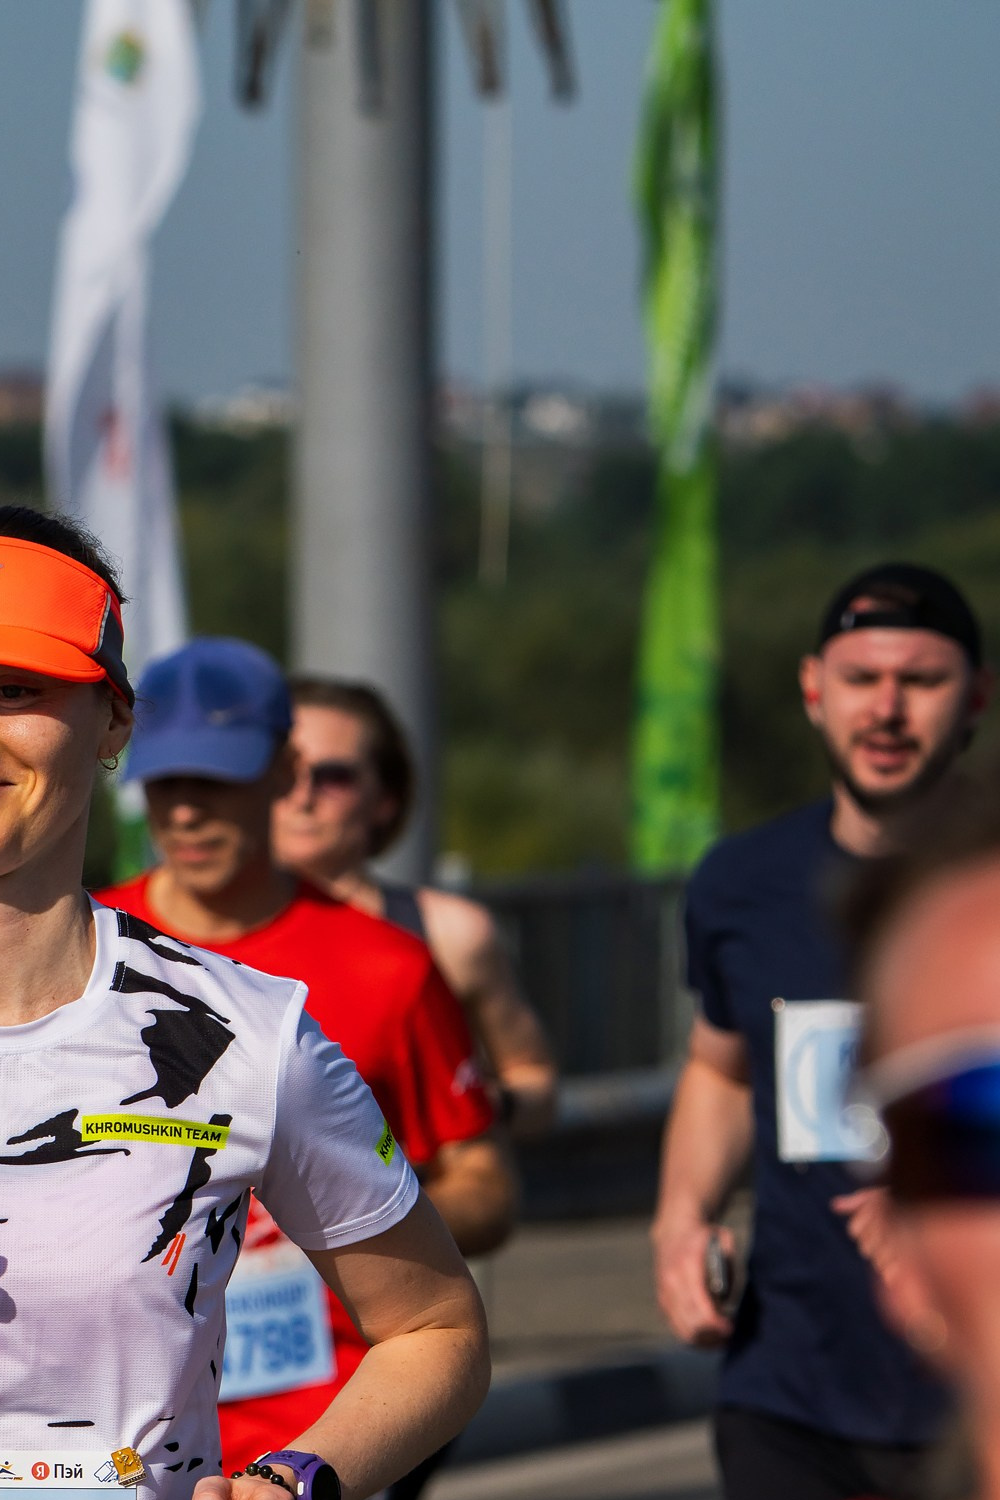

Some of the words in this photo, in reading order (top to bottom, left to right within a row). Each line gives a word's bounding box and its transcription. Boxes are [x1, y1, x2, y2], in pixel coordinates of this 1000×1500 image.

[85, 1121, 182, 1138] KHROMUSHKIN
[185, 1127, 222, 1142] TEAM
[54, 1463, 83, 1479] Пэй
